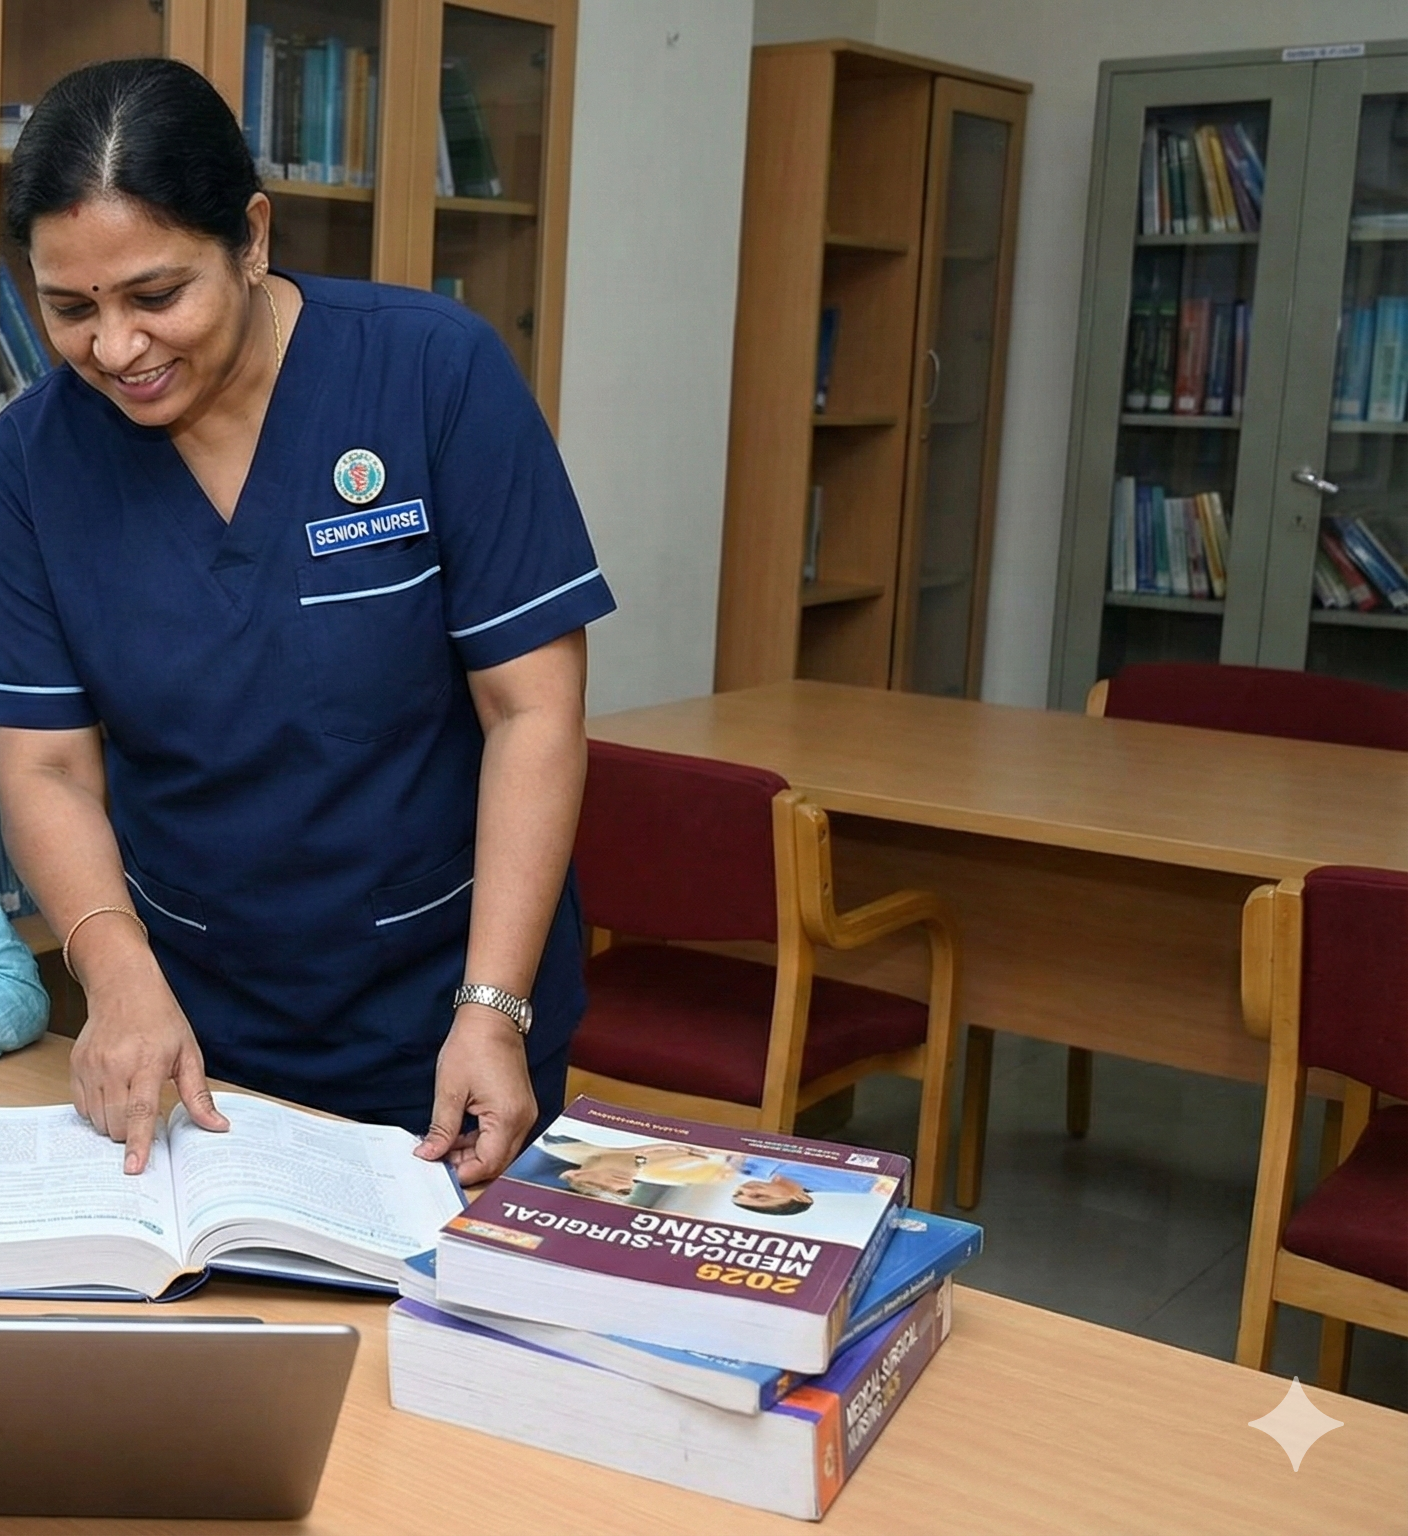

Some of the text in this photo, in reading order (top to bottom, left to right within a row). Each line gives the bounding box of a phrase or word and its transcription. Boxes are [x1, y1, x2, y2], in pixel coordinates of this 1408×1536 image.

[315, 509, 421, 546] SENIOR NURSE
[503, 1202, 812, 1277] MEDICAL-SURGICAL
[630, 1212, 822, 1262] NURSING
